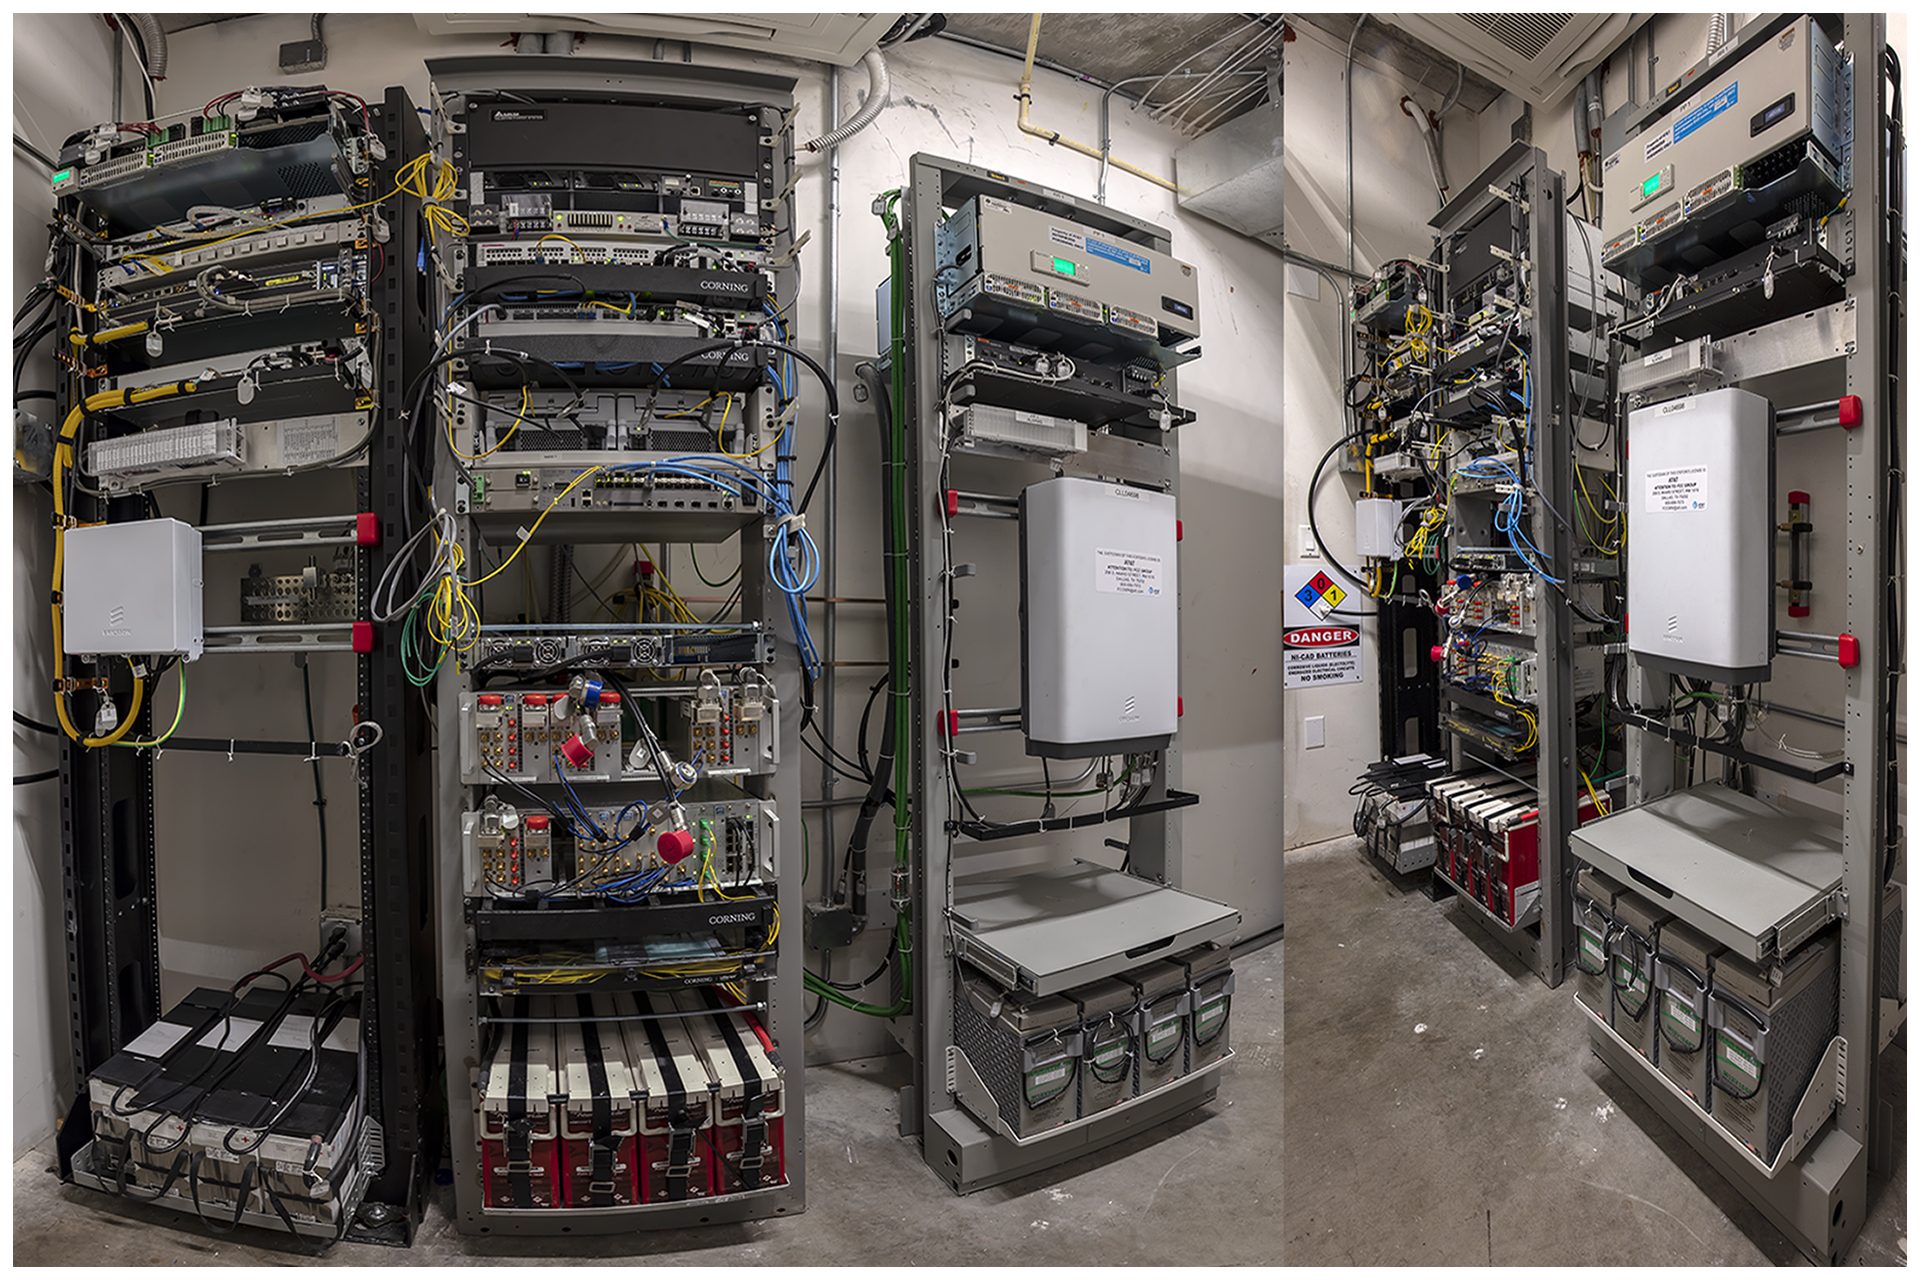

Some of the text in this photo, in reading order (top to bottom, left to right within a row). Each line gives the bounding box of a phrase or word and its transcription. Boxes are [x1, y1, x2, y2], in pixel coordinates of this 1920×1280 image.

[700, 280, 748, 293] CORNING
[701, 351, 749, 361] CORING
[1317, 578, 1325, 589] 0
[1304, 590, 1337, 602] 3 1
[1290, 631, 1352, 643] DANGER
[1317, 651, 1352, 659] BATTERIES
[1313, 672, 1344, 680] SMOKING
[709, 912, 756, 924] CORNING
